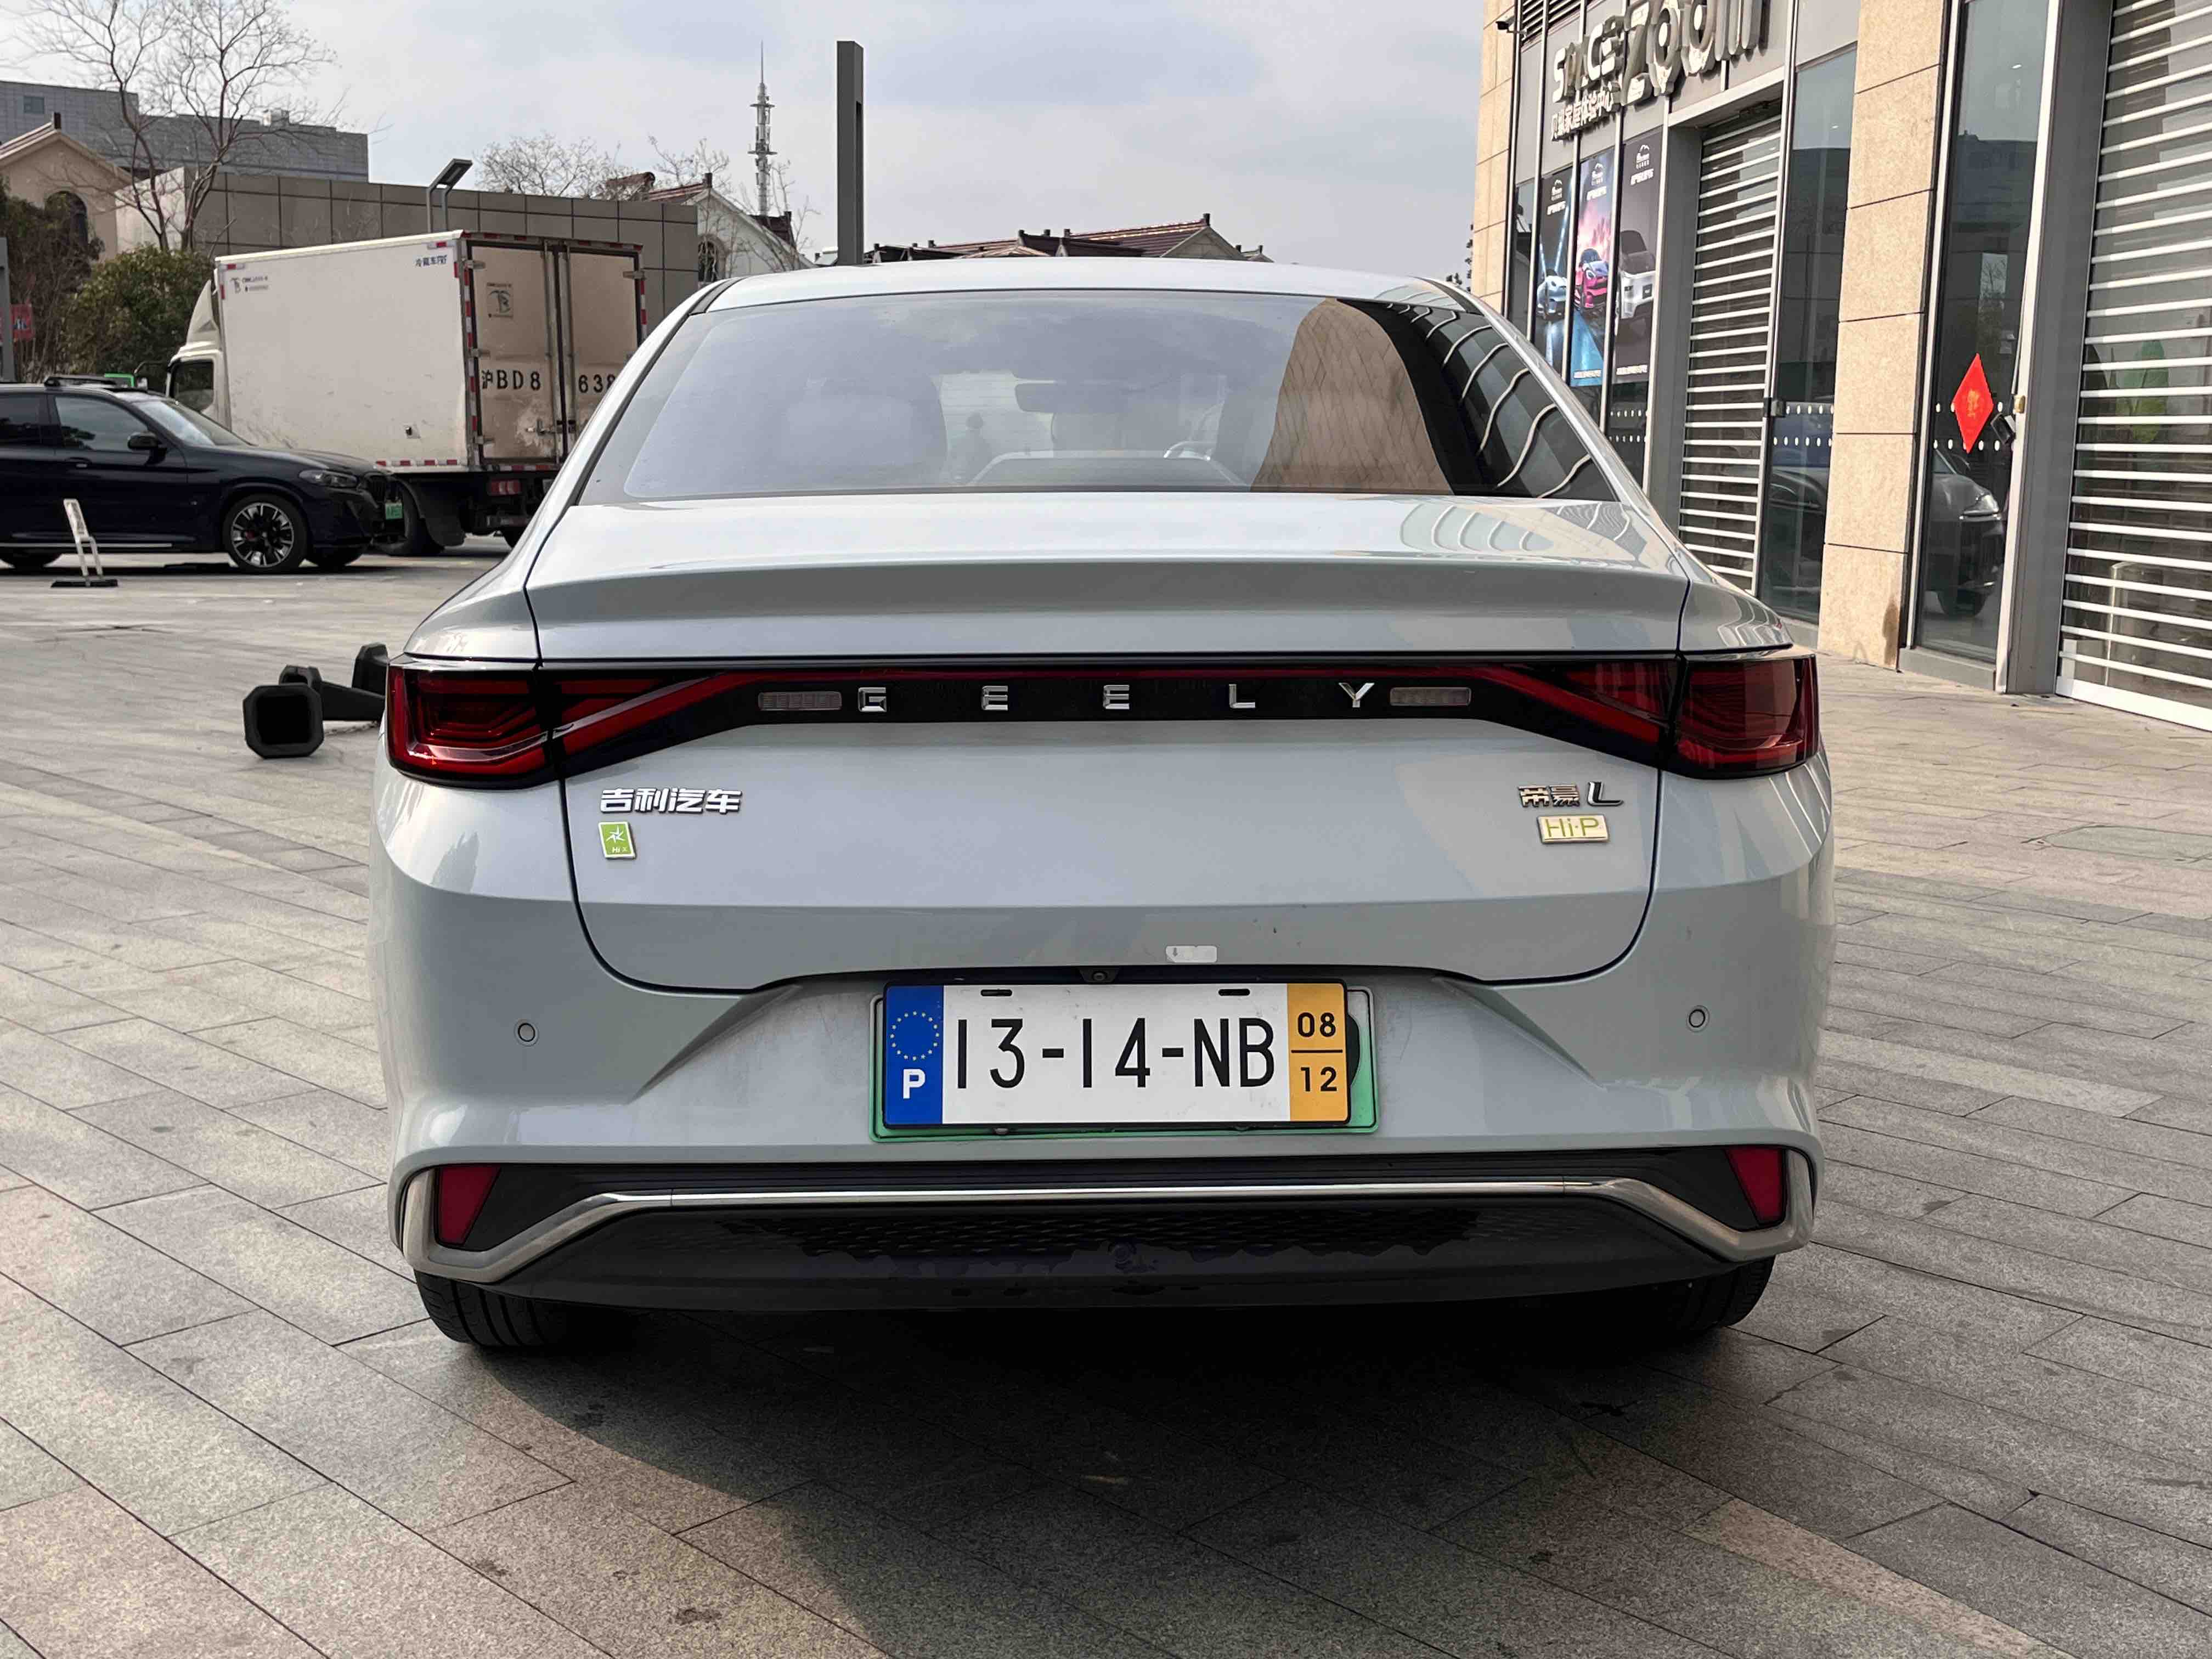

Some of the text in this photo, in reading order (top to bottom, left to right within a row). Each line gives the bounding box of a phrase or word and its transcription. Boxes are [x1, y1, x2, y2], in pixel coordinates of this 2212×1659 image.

[858, 682, 1375, 713] GEELY
[601, 788, 742, 813] 吉利汽车
[1587, 781, 1624, 806] L
[1297, 1012, 1336, 1038] 08
[957, 1017, 1275, 1089] 13-14-NB
[902, 1068, 926, 1099] P
[1300, 1066, 1338, 1092] 12
